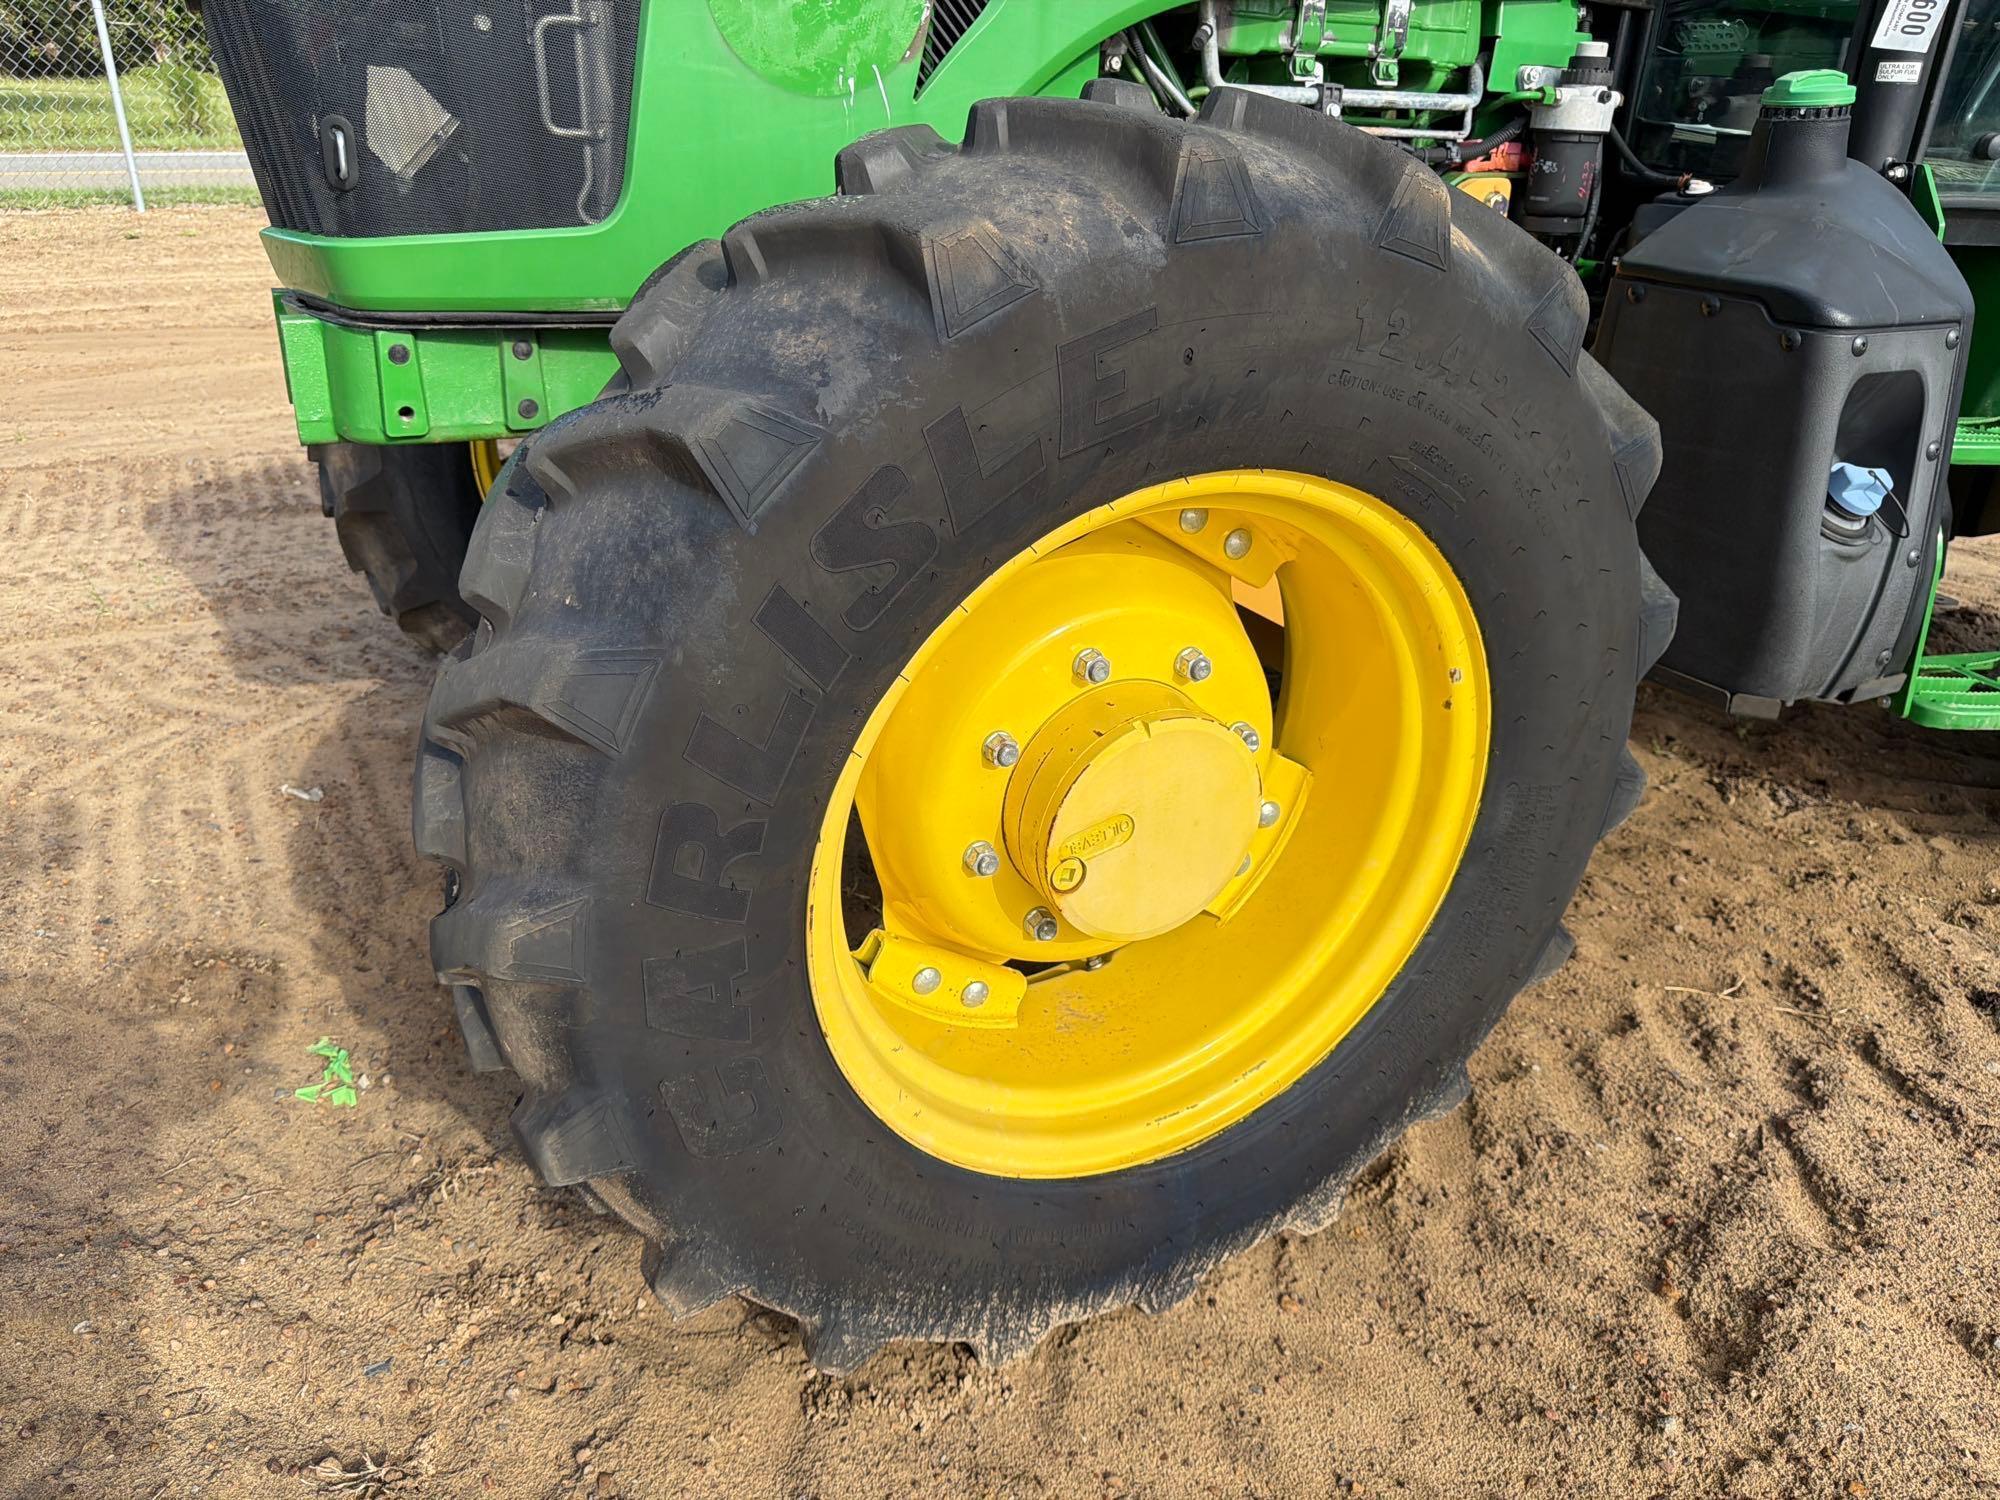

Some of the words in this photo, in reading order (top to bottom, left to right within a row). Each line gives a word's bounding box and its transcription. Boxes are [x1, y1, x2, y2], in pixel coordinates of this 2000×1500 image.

[1381, 383, 1405, 401] USE
[645, 307, 1162, 1160] CARLISLE
[1107, 819, 1131, 837] OIL
[1065, 829, 1107, 856] LEVEL
